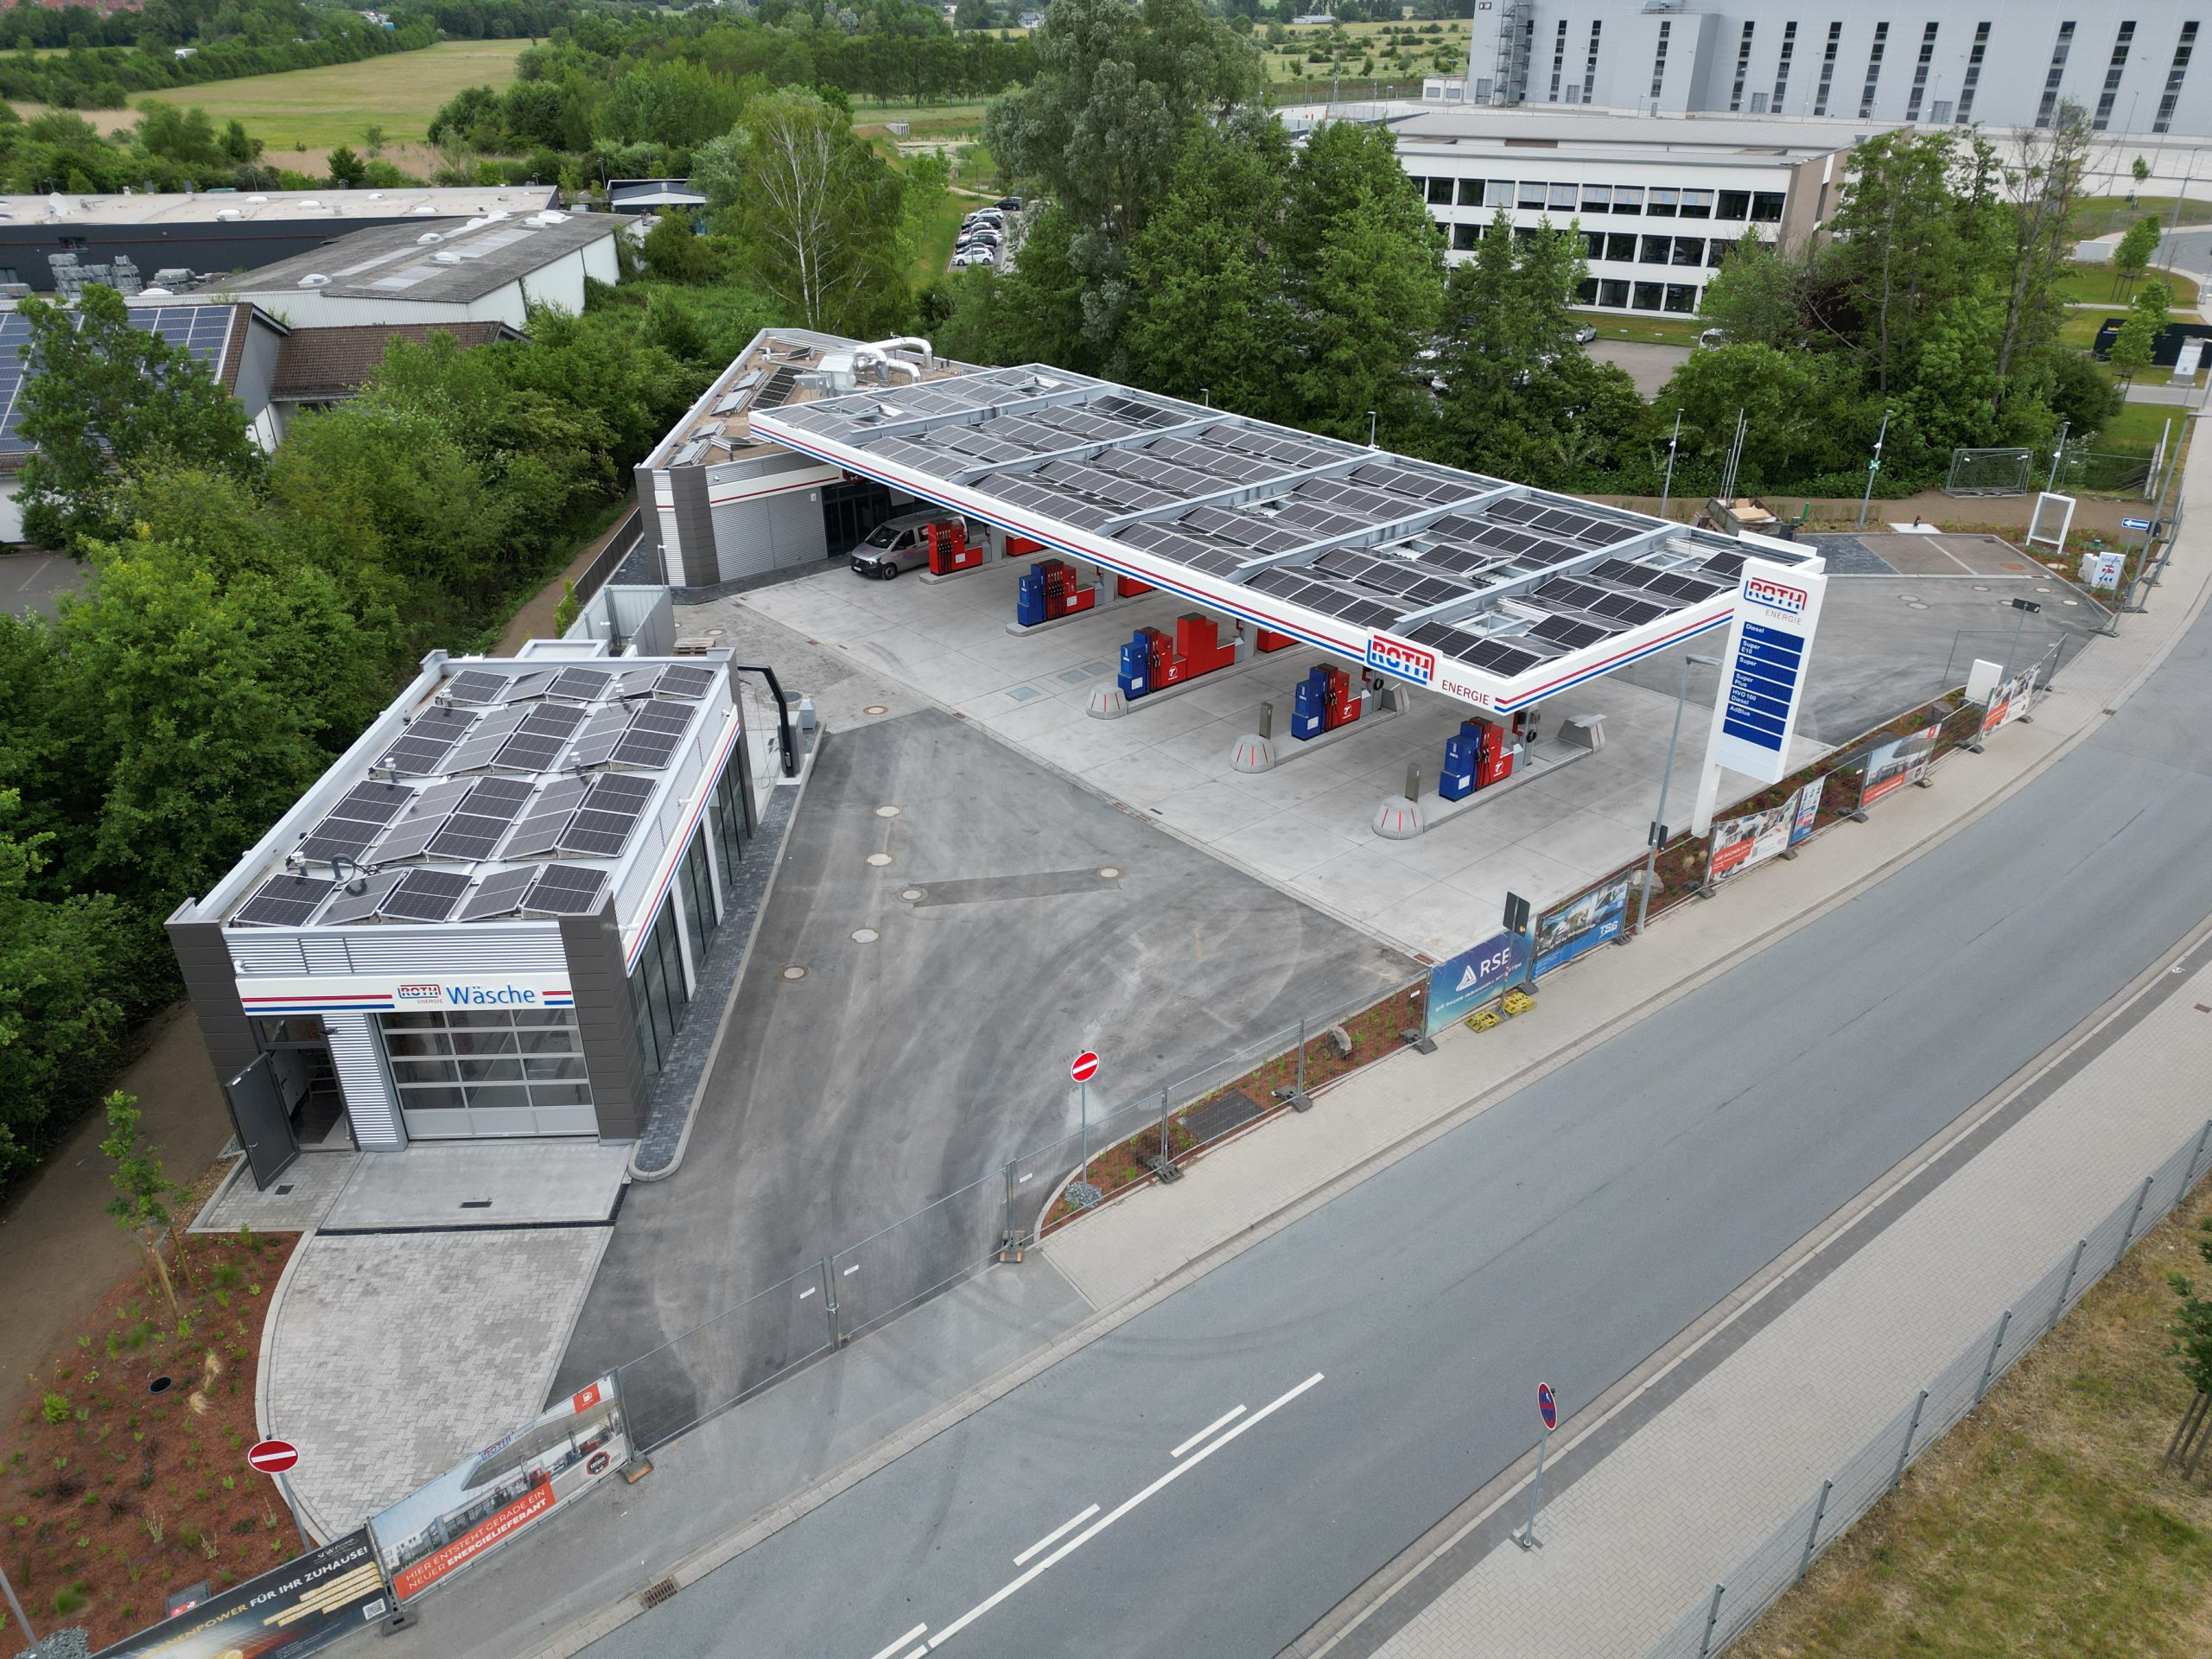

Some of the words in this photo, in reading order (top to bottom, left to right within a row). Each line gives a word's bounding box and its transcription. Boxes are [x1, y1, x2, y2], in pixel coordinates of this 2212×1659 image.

[1748, 581, 1802, 610] ROTH
[1765, 609, 1802, 626] ENERGIE
[1745, 623, 1764, 634] Diesel
[1740, 646, 1753, 655] E10
[1742, 640, 1761, 651] Super
[1371, 640, 1430, 679] ROTH
[1738, 656, 1758, 667] Super
[1734, 679, 1748, 689] Plus
[1735, 673, 1754, 683] Super
[1441, 679, 1490, 706] ENERGIE
[1732, 689, 1746, 697] HVO
[1745, 692, 1757, 701] 100
[1731, 696, 1750, 705] Diesel
[1729, 705, 1751, 717] AdBlue
[1599, 920, 1618, 937] TSG
[1479, 947, 1510, 978] RSE
[400, 986, 439, 996] ROTH
[446, 983, 536, 1005] Wäsche
[405, 1561, 433, 1581] HIER
[434, 1529, 484, 1566] ENTSTEHT
[486, 1501, 527, 1531] GERADE
[528, 1489, 545, 1503] EIN
[409, 1563, 446, 1590] NEUER
[447, 1497, 547, 1567] ENERGIELIEFERANT
[250, 1591, 277, 1607] FÜR
[278, 1579, 303, 1594] IHR
[304, 1546, 368, 1582] ZUHAUSE!
